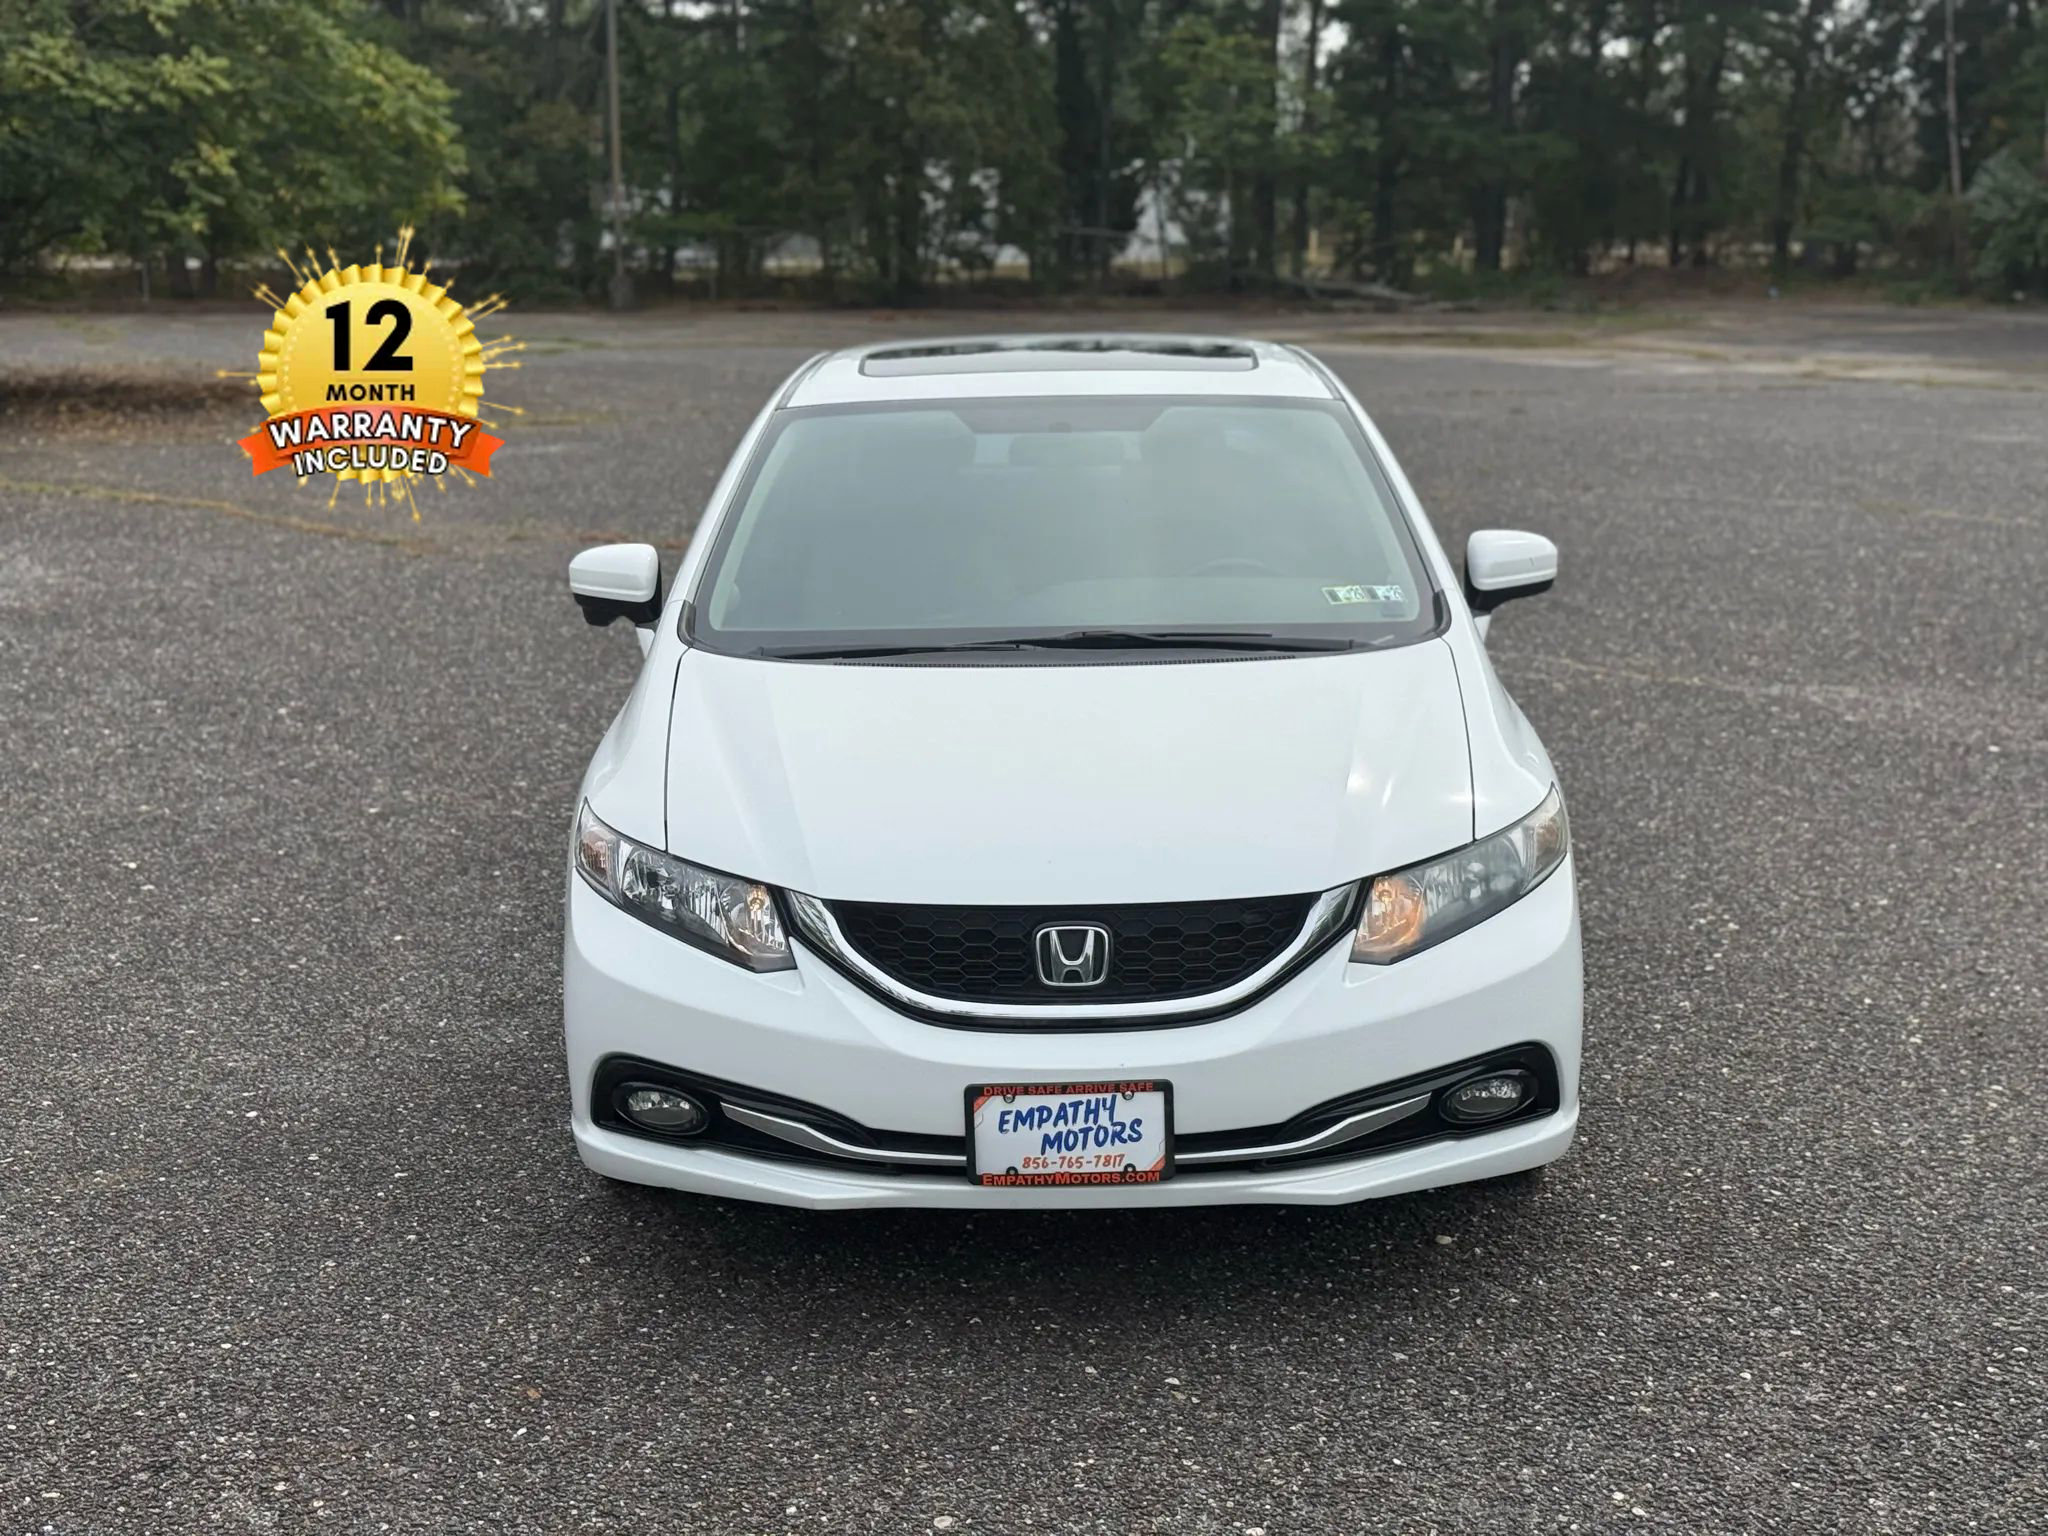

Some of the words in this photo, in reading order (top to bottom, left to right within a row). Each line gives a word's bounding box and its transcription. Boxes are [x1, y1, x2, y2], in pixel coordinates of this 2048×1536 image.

[983, 1085, 1025, 1097] DRIVE
[1027, 1084, 1062, 1096] SAFE
[1066, 1083, 1115, 1095] ARRIVE
[1119, 1081, 1153, 1093] SAFE
[998, 1094, 1117, 1134] EMPATHY
[1041, 1118, 1143, 1156] MOTORS
[1022, 1153, 1126, 1169] 856-765-7817
